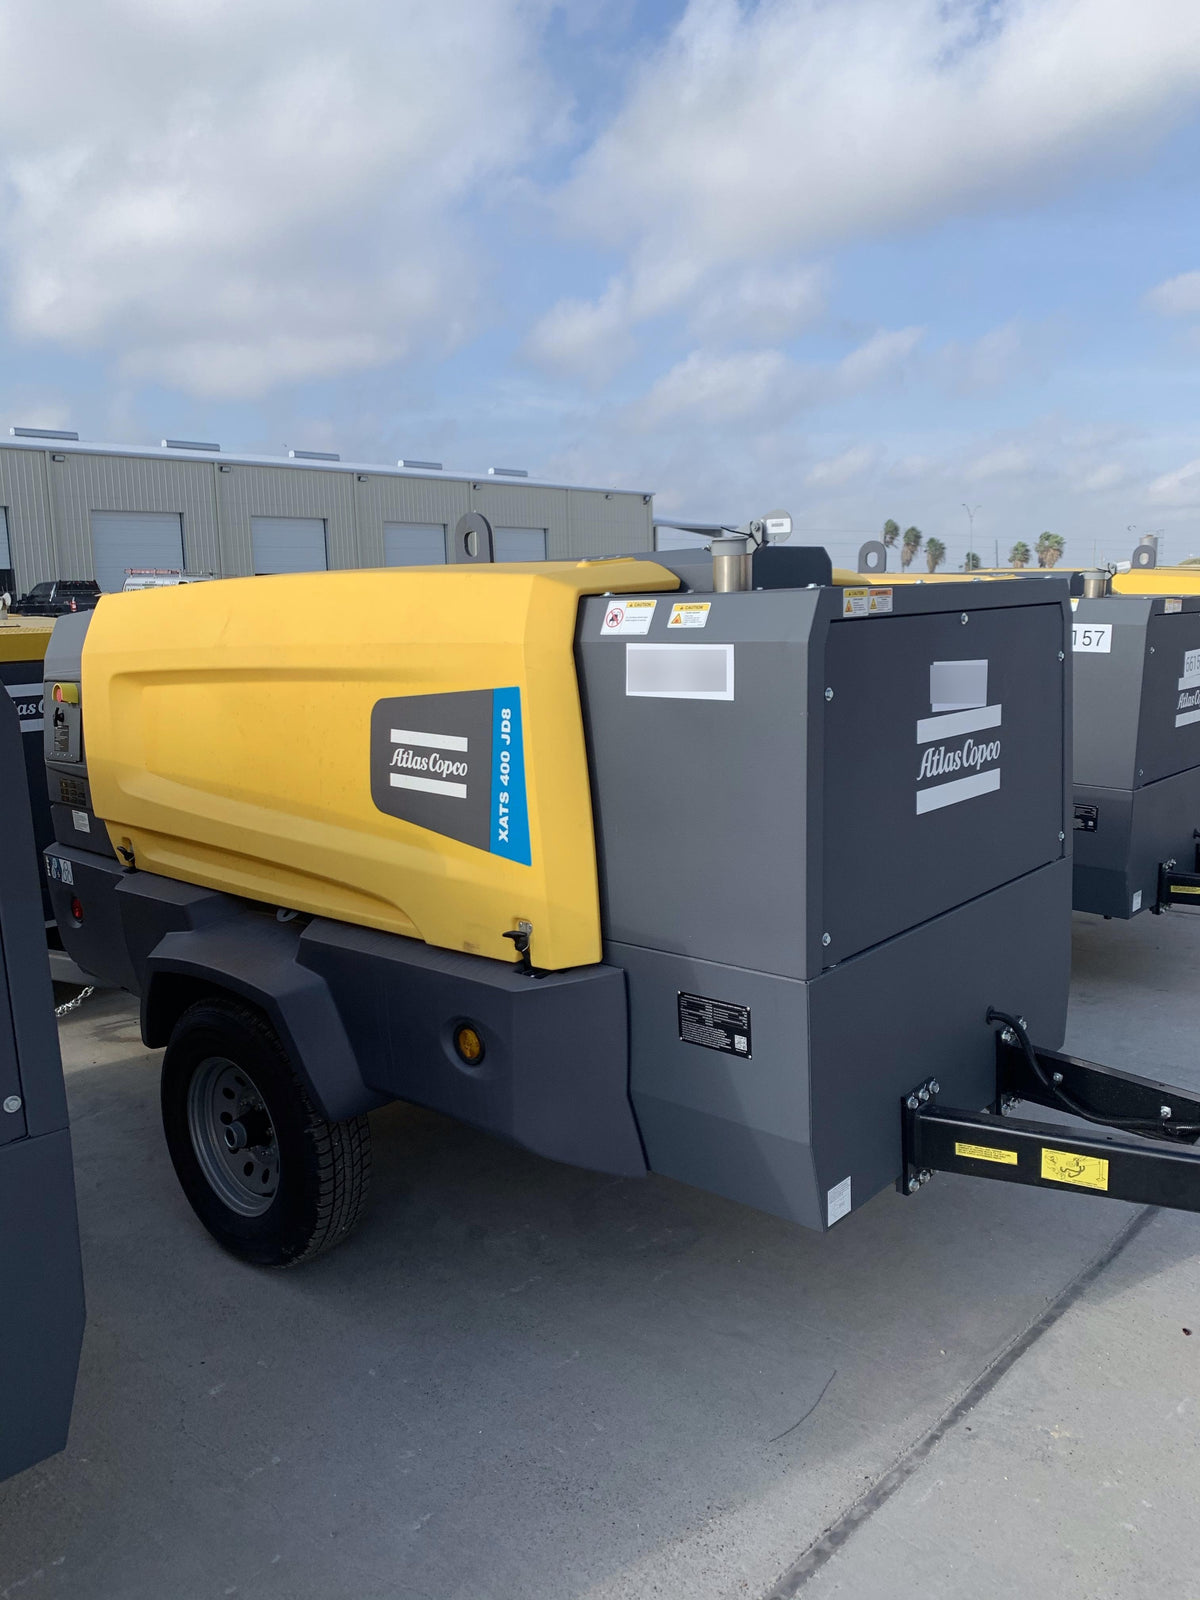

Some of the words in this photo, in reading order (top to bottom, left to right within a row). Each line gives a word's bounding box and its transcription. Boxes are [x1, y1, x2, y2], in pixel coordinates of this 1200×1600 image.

[1071, 630, 1105, 647] 157
[1176, 691, 1195, 710] Atlas
[501, 708, 512, 746] JD8
[389, 747, 429, 772] Atlas
[428, 752, 468, 778] Copco
[500, 750, 511, 786] 400
[916, 746, 962, 781] Atlas
[962, 738, 1001, 771] Copco
[498, 791, 510, 843] XATS
